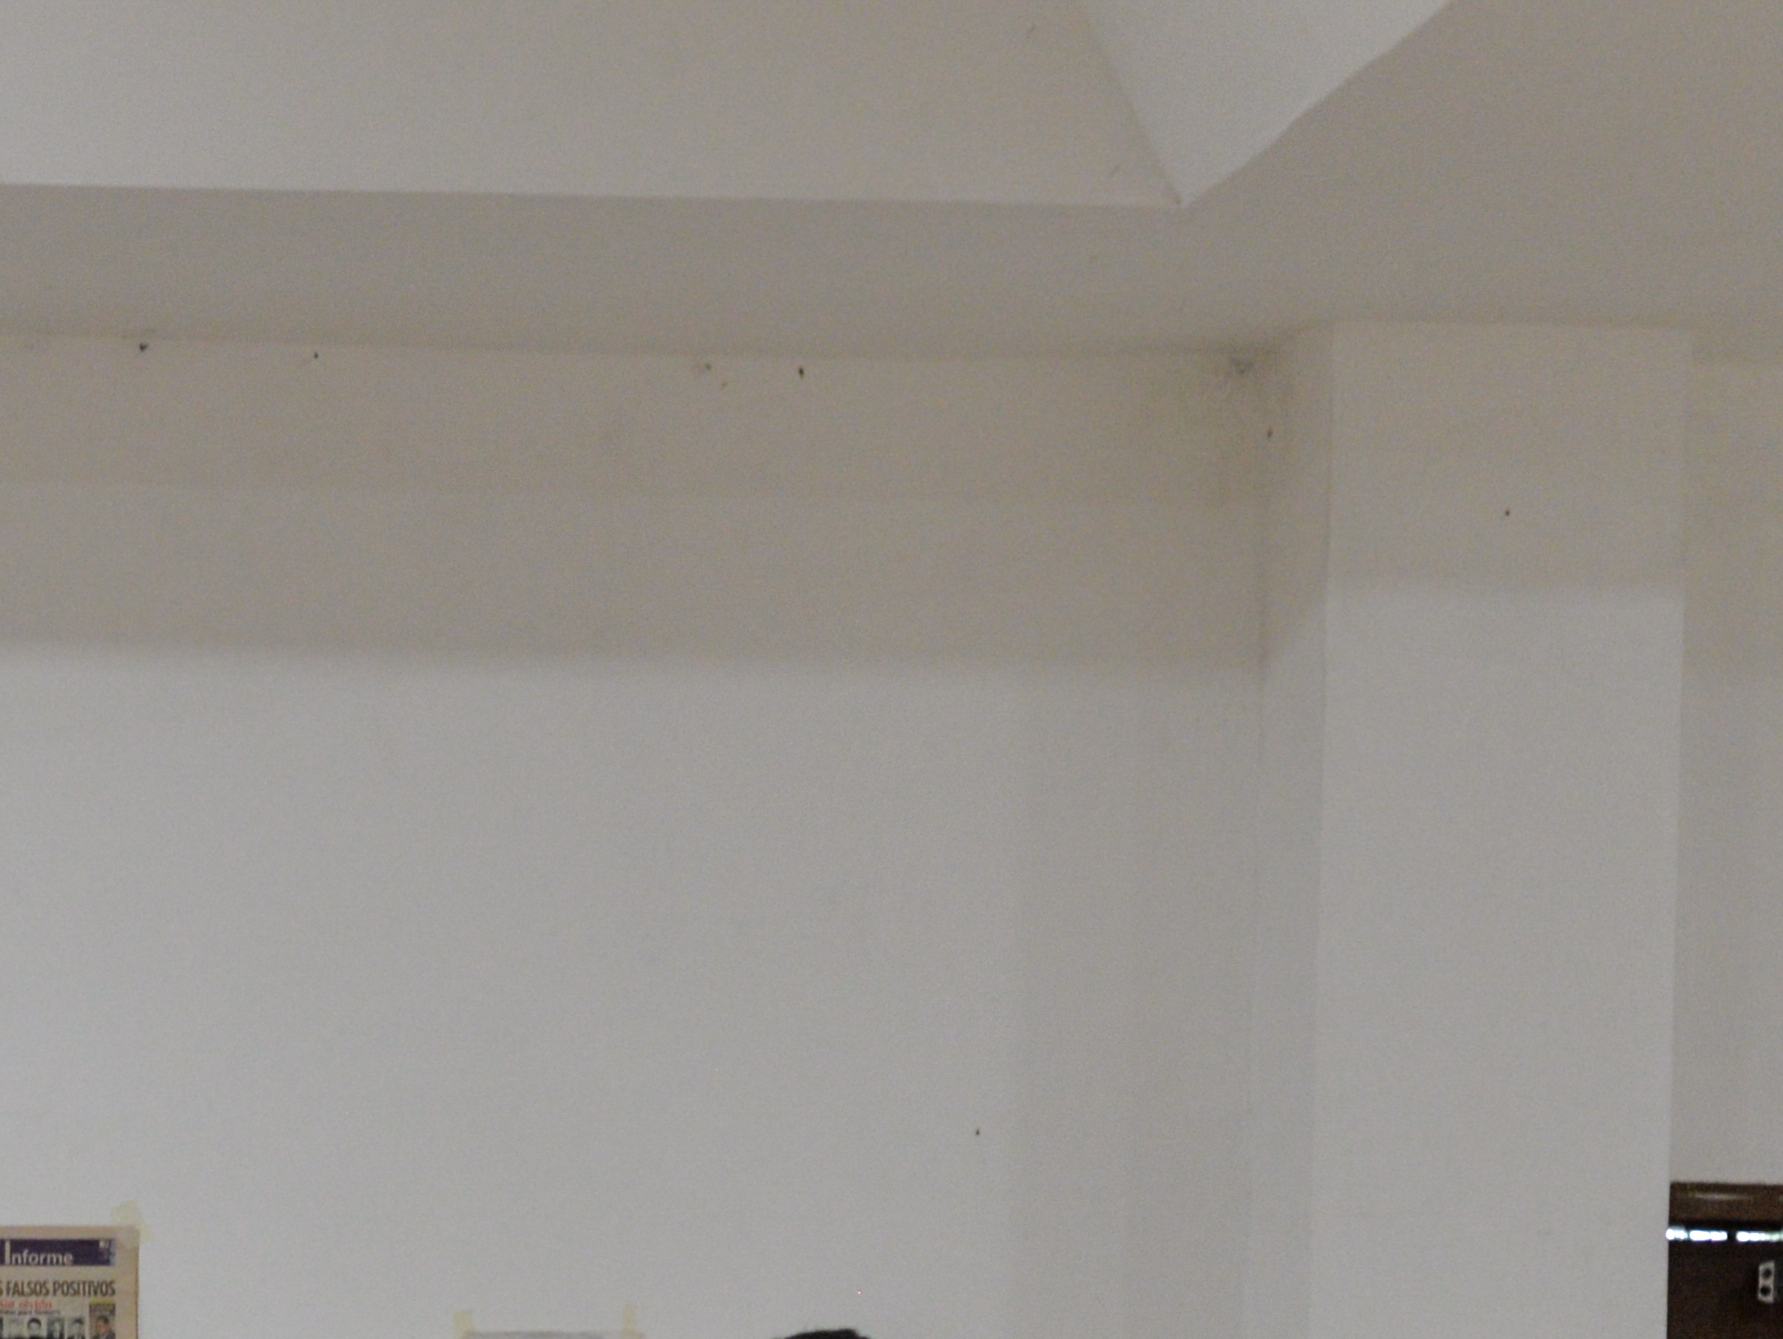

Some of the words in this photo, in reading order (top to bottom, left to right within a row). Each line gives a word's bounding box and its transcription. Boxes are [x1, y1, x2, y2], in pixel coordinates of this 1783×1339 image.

[4, 1241, 73, 1266] Informe
[6, 1281, 50, 1297] FALSOS
[53, 1280, 116, 1297] POSITIVOS
